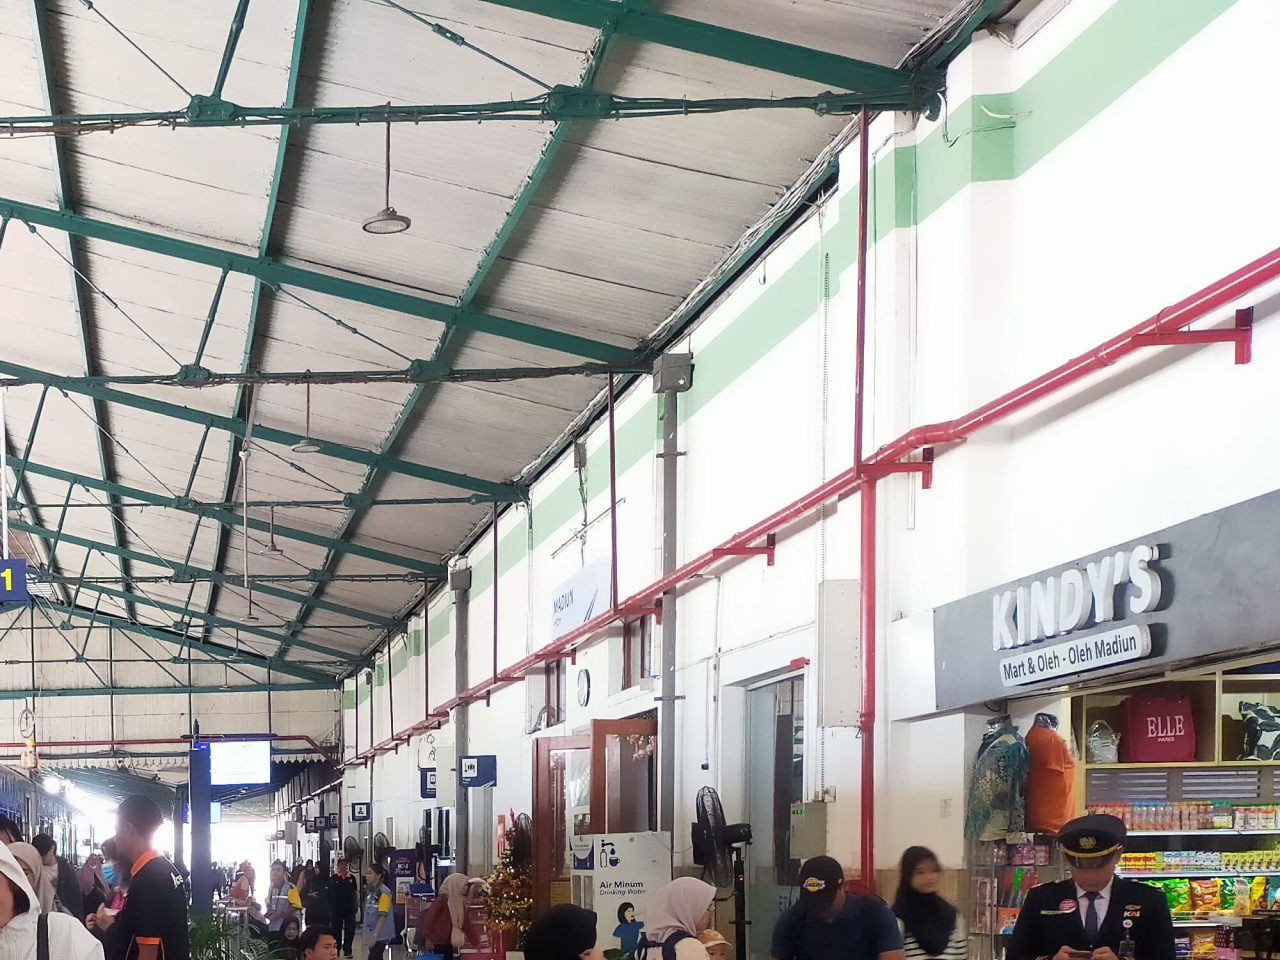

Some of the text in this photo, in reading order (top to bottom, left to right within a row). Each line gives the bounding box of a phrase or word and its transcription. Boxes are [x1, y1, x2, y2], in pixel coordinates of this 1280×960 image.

[0, 568, 13, 591] 1
[992, 544, 1162, 651] KINDY'S
[1003, 658, 1027, 681] Mart
[1027, 656, 1036, 674] &
[1037, 648, 1061, 672] Oleh
[1068, 642, 1093, 665] Oleh
[1094, 633, 1137, 661] Madiun
[1146, 715, 1185, 737] ELLE
[599, 880, 644, 889] Air Minum
[599, 888, 646, 897] Drinking Water
